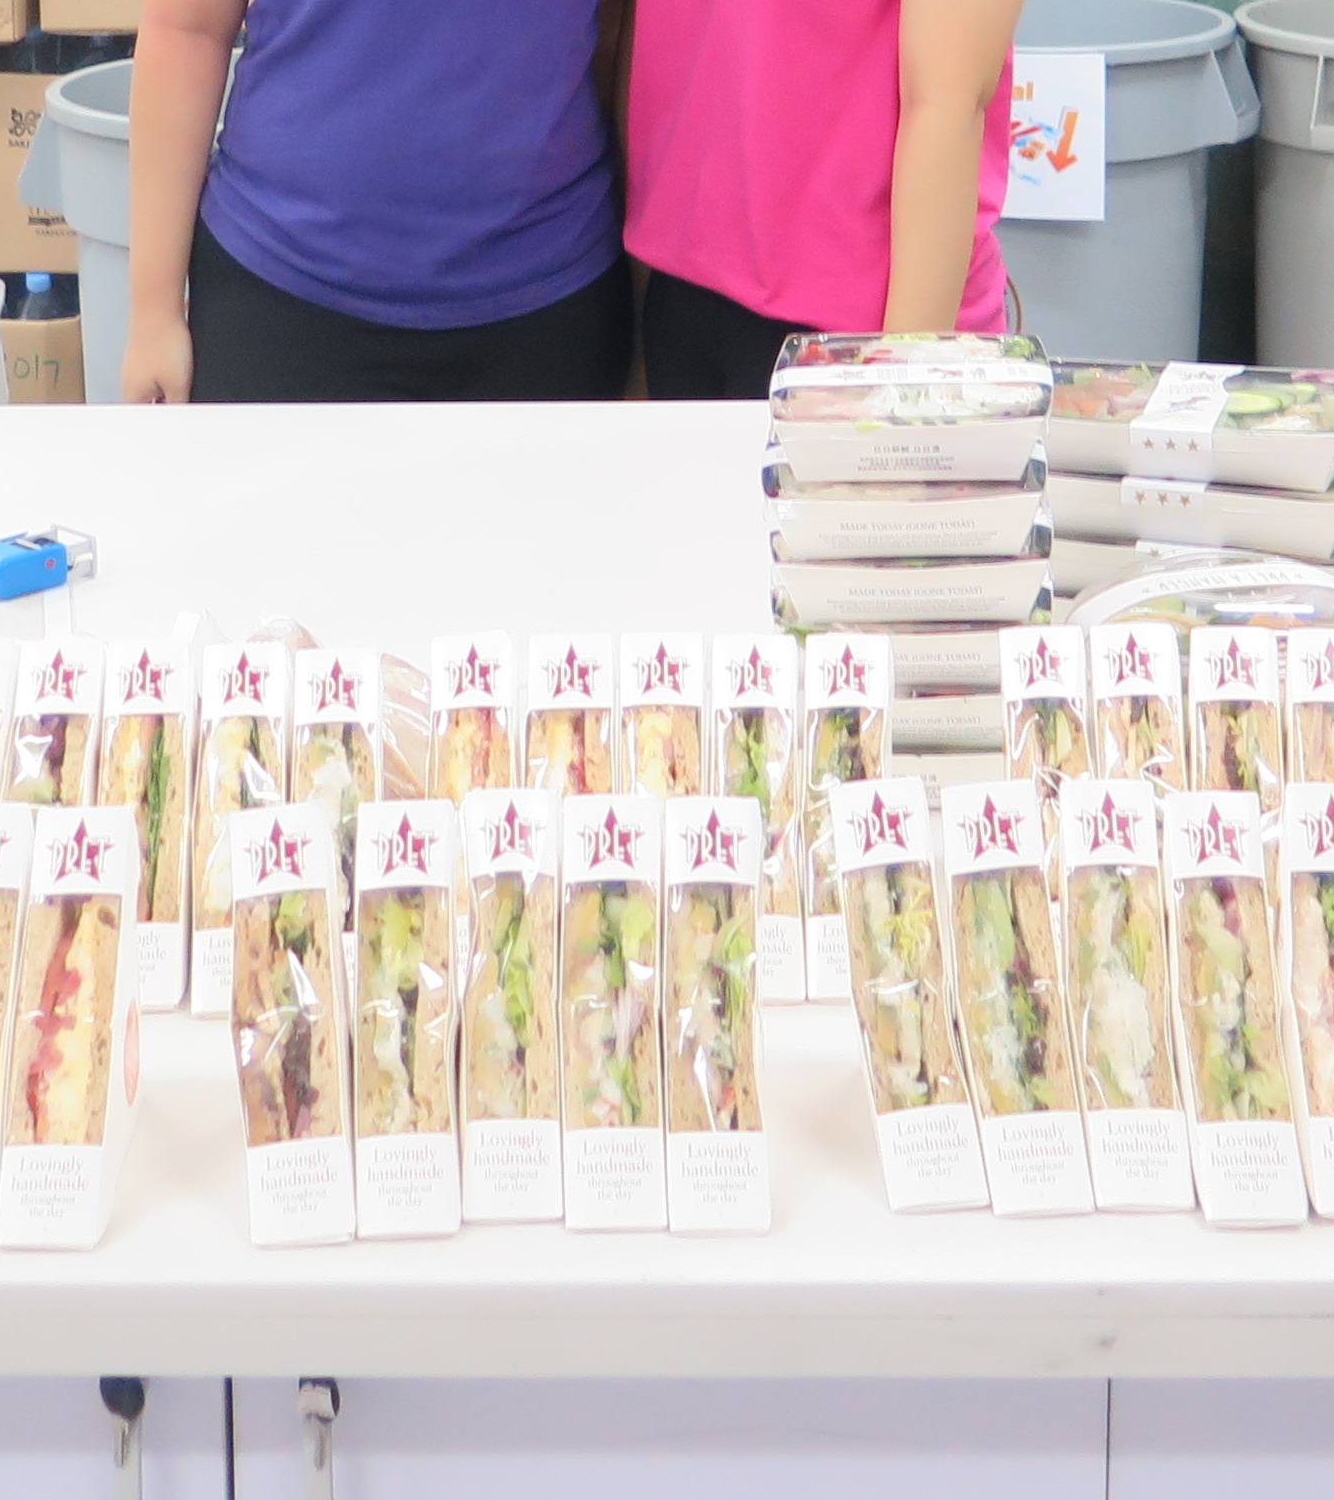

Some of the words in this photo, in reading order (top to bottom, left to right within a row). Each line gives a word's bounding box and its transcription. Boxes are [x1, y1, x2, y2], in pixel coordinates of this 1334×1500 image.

[32, 664, 86, 696] PRET
[118, 664, 172, 696] PRET
[449, 658, 499, 692] PRET
[548, 659, 600, 692] PRET
[637, 655, 691, 690] PRET
[824, 657, 878, 692] PRET
[1107, 648, 1160, 684] PRET
[1210, 651, 1263, 686] PRET
[310, 674, 363, 707] PRET
[580, 826, 645, 866] PRET
[683, 826, 746, 866] PRET
[852, 811, 912, 851] PRET
[962, 816, 1025, 853] PRET
[1079, 811, 1141, 851] PRET
[1187, 820, 1249, 858] PRET
[46, 836, 114, 878] PRET
[248, 831, 311, 875] PRET
[375, 831, 439, 868] PRET
[897, 1116, 960, 1140] Lovingly
[1216, 1130, 1279, 1152] Lovingly
[374, 1145, 437, 1167] Lovingly
[584, 1138, 647, 1160] Lovingly
[893, 1135, 969, 1156] handmade
[1211, 1148, 1288, 1168] handmade
[368, 1163, 445, 1183] handmade
[577, 1156, 654, 1176] handmade
